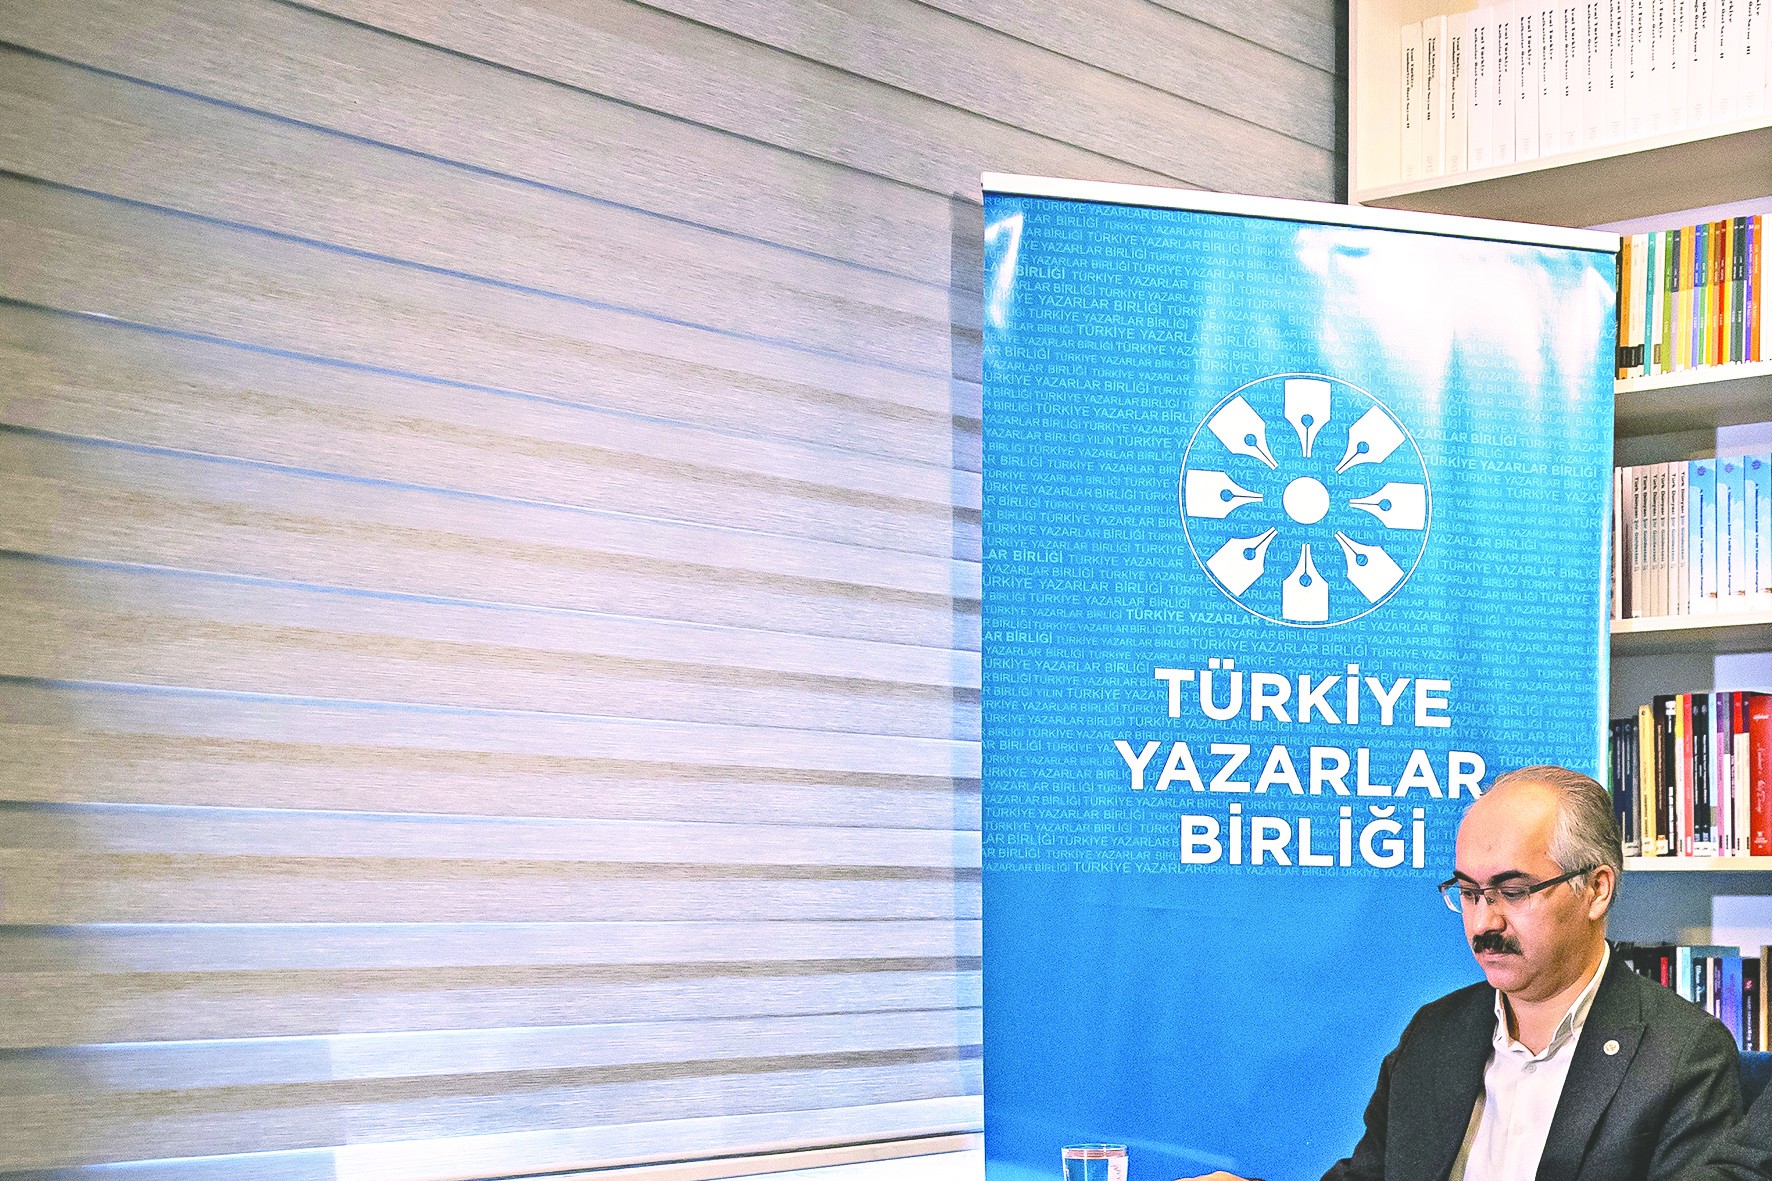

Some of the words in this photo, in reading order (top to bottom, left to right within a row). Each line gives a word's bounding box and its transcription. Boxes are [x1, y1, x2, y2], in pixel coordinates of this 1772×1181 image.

[1423, 456, 1477, 470] TÜRKİYE
[1480, 460, 1547, 474] YAZARLAR
[1551, 463, 1598, 478] BİRLİĞİ
[1006, 630, 1053, 644] BİRLİĞİ
[1126, 609, 1185, 623] TÜRKİYE
[1188, 611, 1260, 626] YAZARLAR
[1155, 658, 1451, 728] TÜRKİYE
[1113, 740, 1487, 799] YAZARLAR
[1180, 803, 1426, 868] BİRLİĞİ
